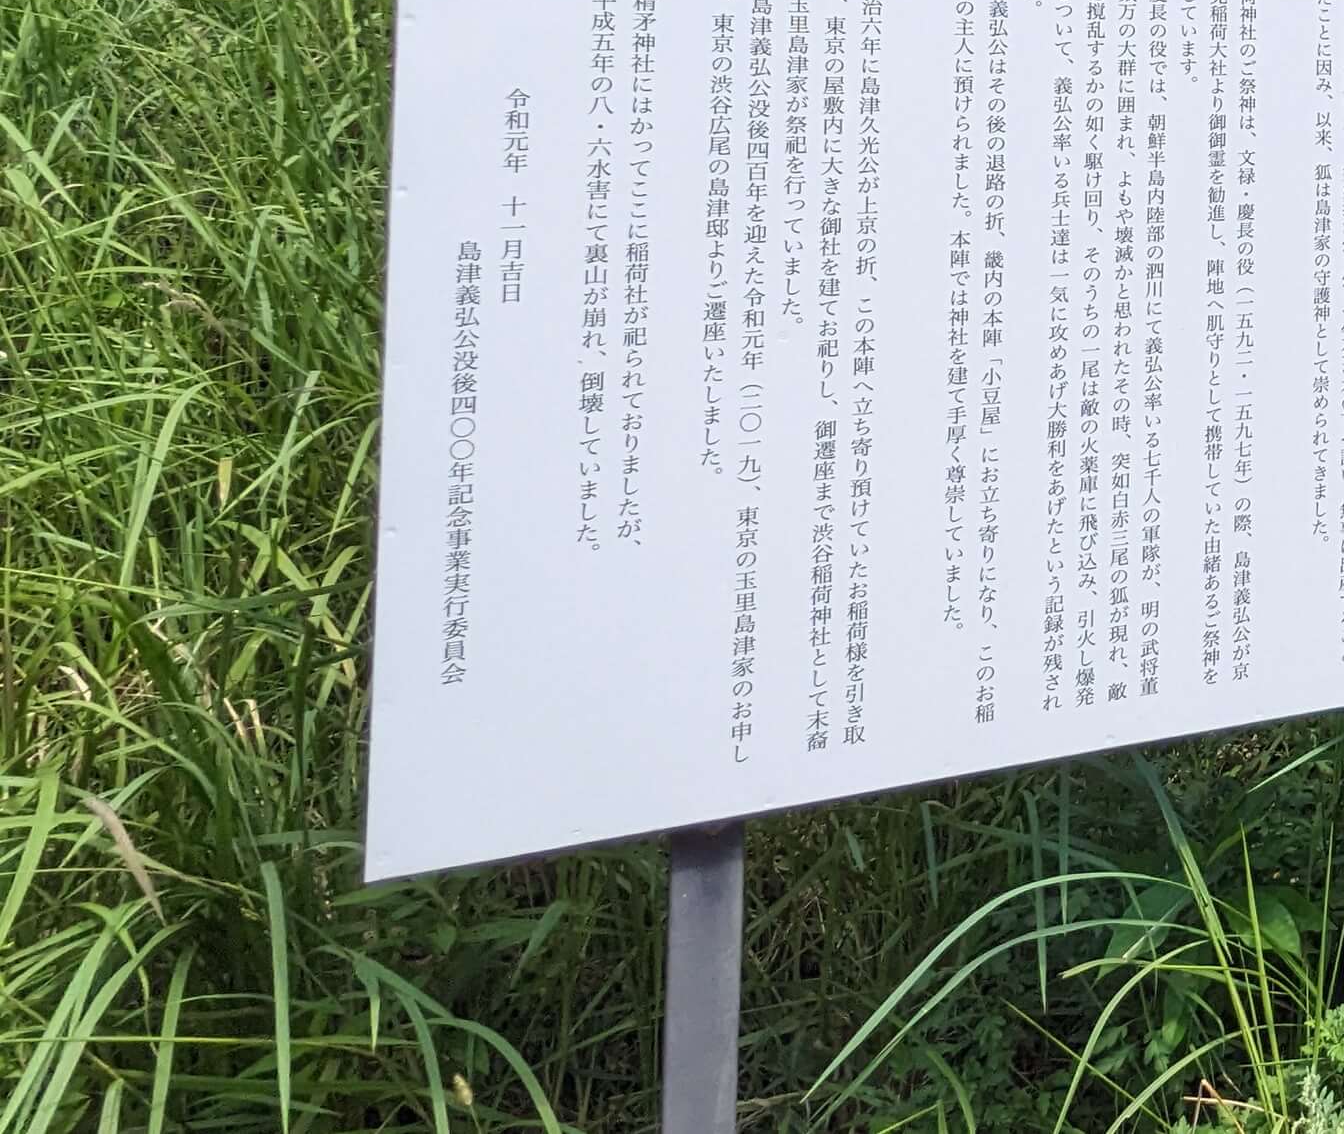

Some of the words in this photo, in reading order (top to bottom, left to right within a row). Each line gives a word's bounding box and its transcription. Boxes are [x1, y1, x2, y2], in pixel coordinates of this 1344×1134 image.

[503, 87, 531, 174] 令和元年
[499, 195, 527, 304] 十一月吉日
